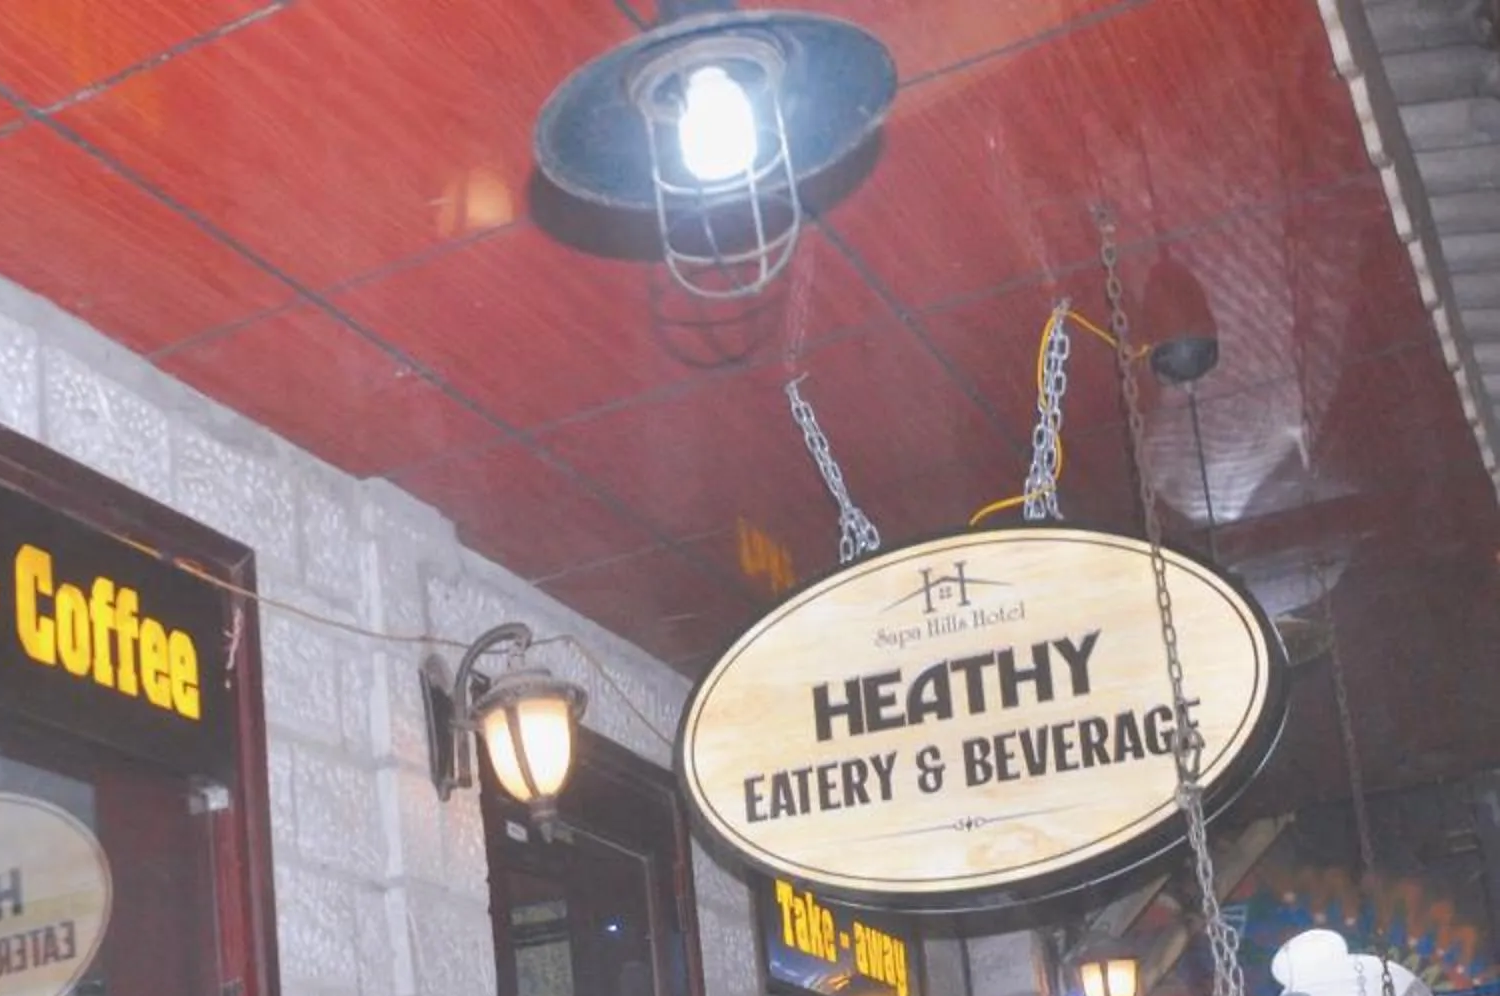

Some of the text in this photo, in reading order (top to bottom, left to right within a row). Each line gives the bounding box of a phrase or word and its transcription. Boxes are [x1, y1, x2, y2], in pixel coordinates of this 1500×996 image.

[13, 543, 202, 720] Coffee
[874, 600, 1026, 650] Sapa Hills Hotel
[813, 630, 1100, 742] HEATHY
[743, 750, 898, 823] EATERY
[915, 745, 945, 794] &
[775, 878, 837, 963] Take
